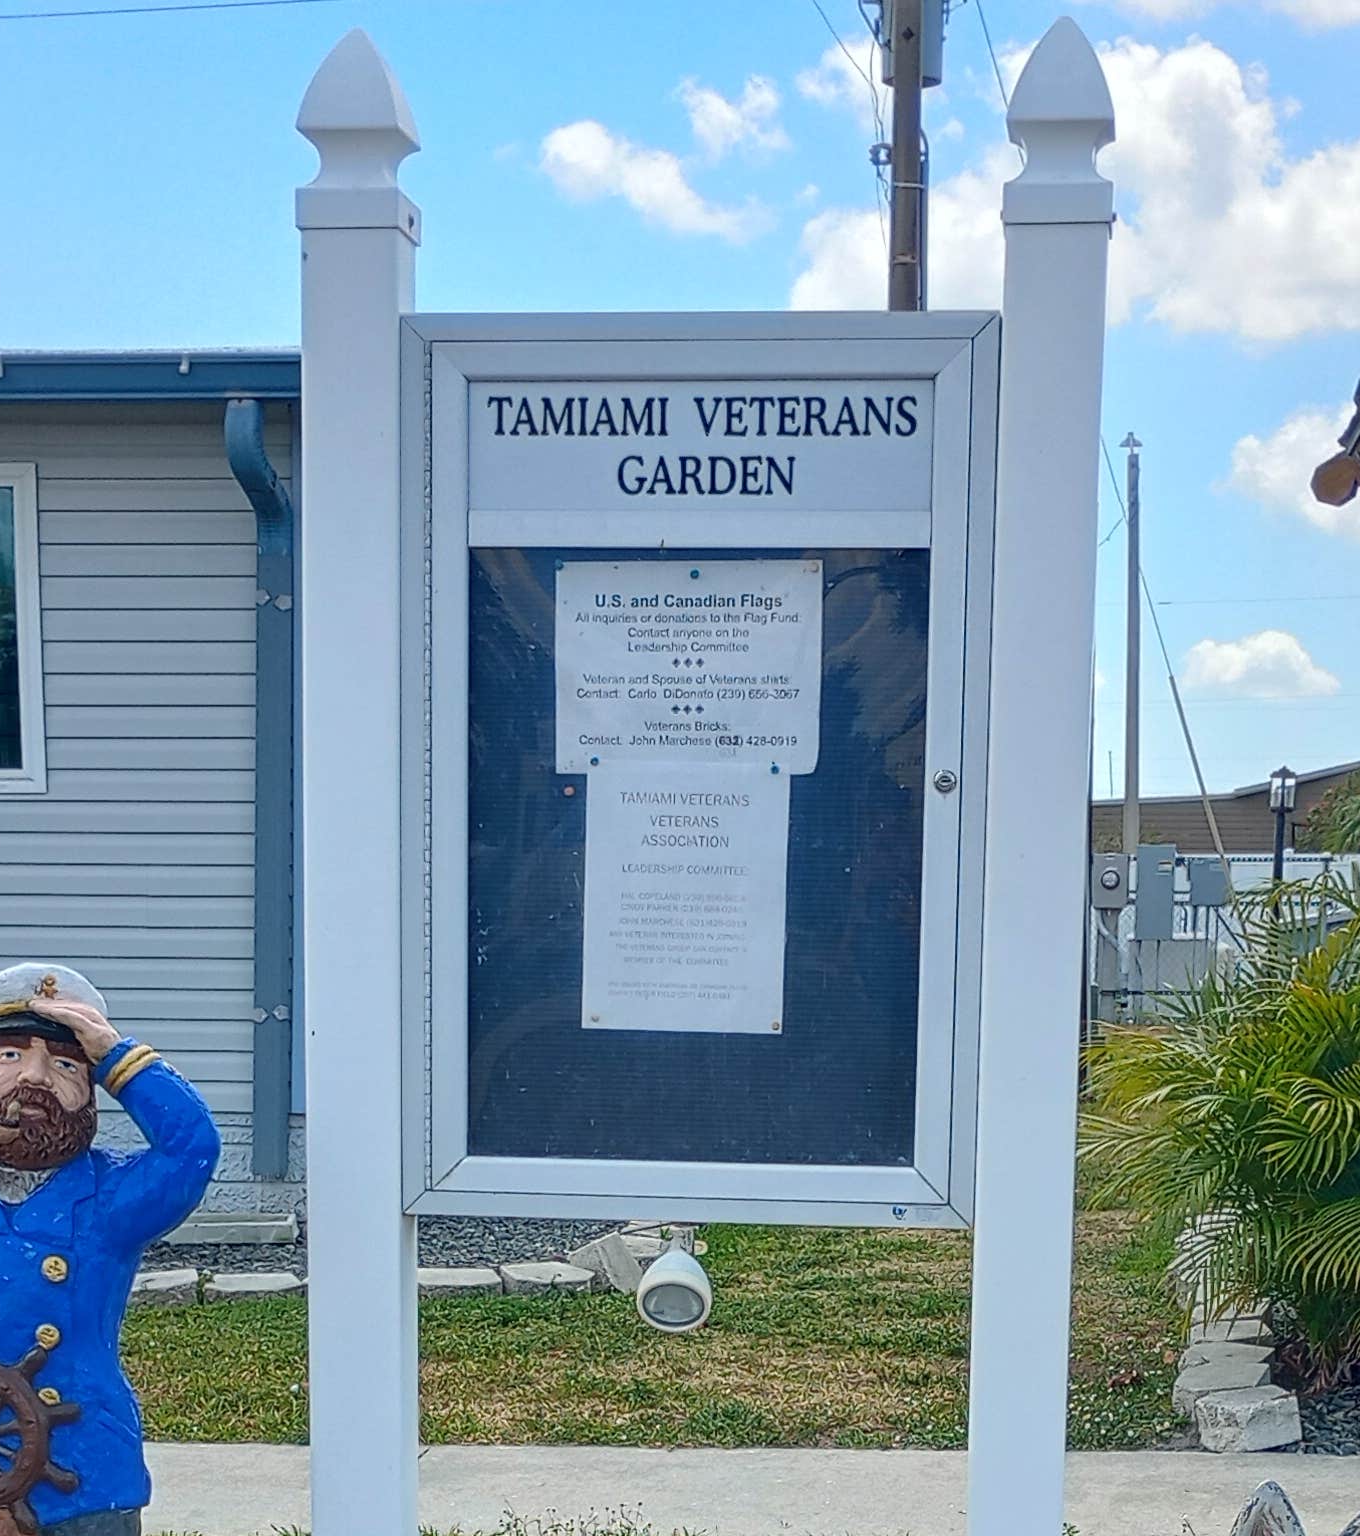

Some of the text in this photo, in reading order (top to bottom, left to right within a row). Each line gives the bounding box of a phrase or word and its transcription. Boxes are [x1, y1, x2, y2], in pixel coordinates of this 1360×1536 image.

[487, 395, 918, 437] TAMIAMI VETERANS
[618, 456, 796, 495] GARDEN
[596, 594, 782, 610] U.S. and Canadian Flags
[640, 614, 651, 622] or
[655, 612, 707, 622] donations
[710, 612, 720, 622] to
[627, 628, 669, 637] Contact
[628, 642, 749, 653] Leadership Committee
[645, 721, 691, 731] Veterans
[629, 735, 655, 746] John
[620, 792, 750, 806] TAMIAMI VETERANS
[650, 816, 719, 828] VETERANS
[641, 835, 729, 848] ASSOCIATION
[622, 864, 684, 874] LEADERSHIP
